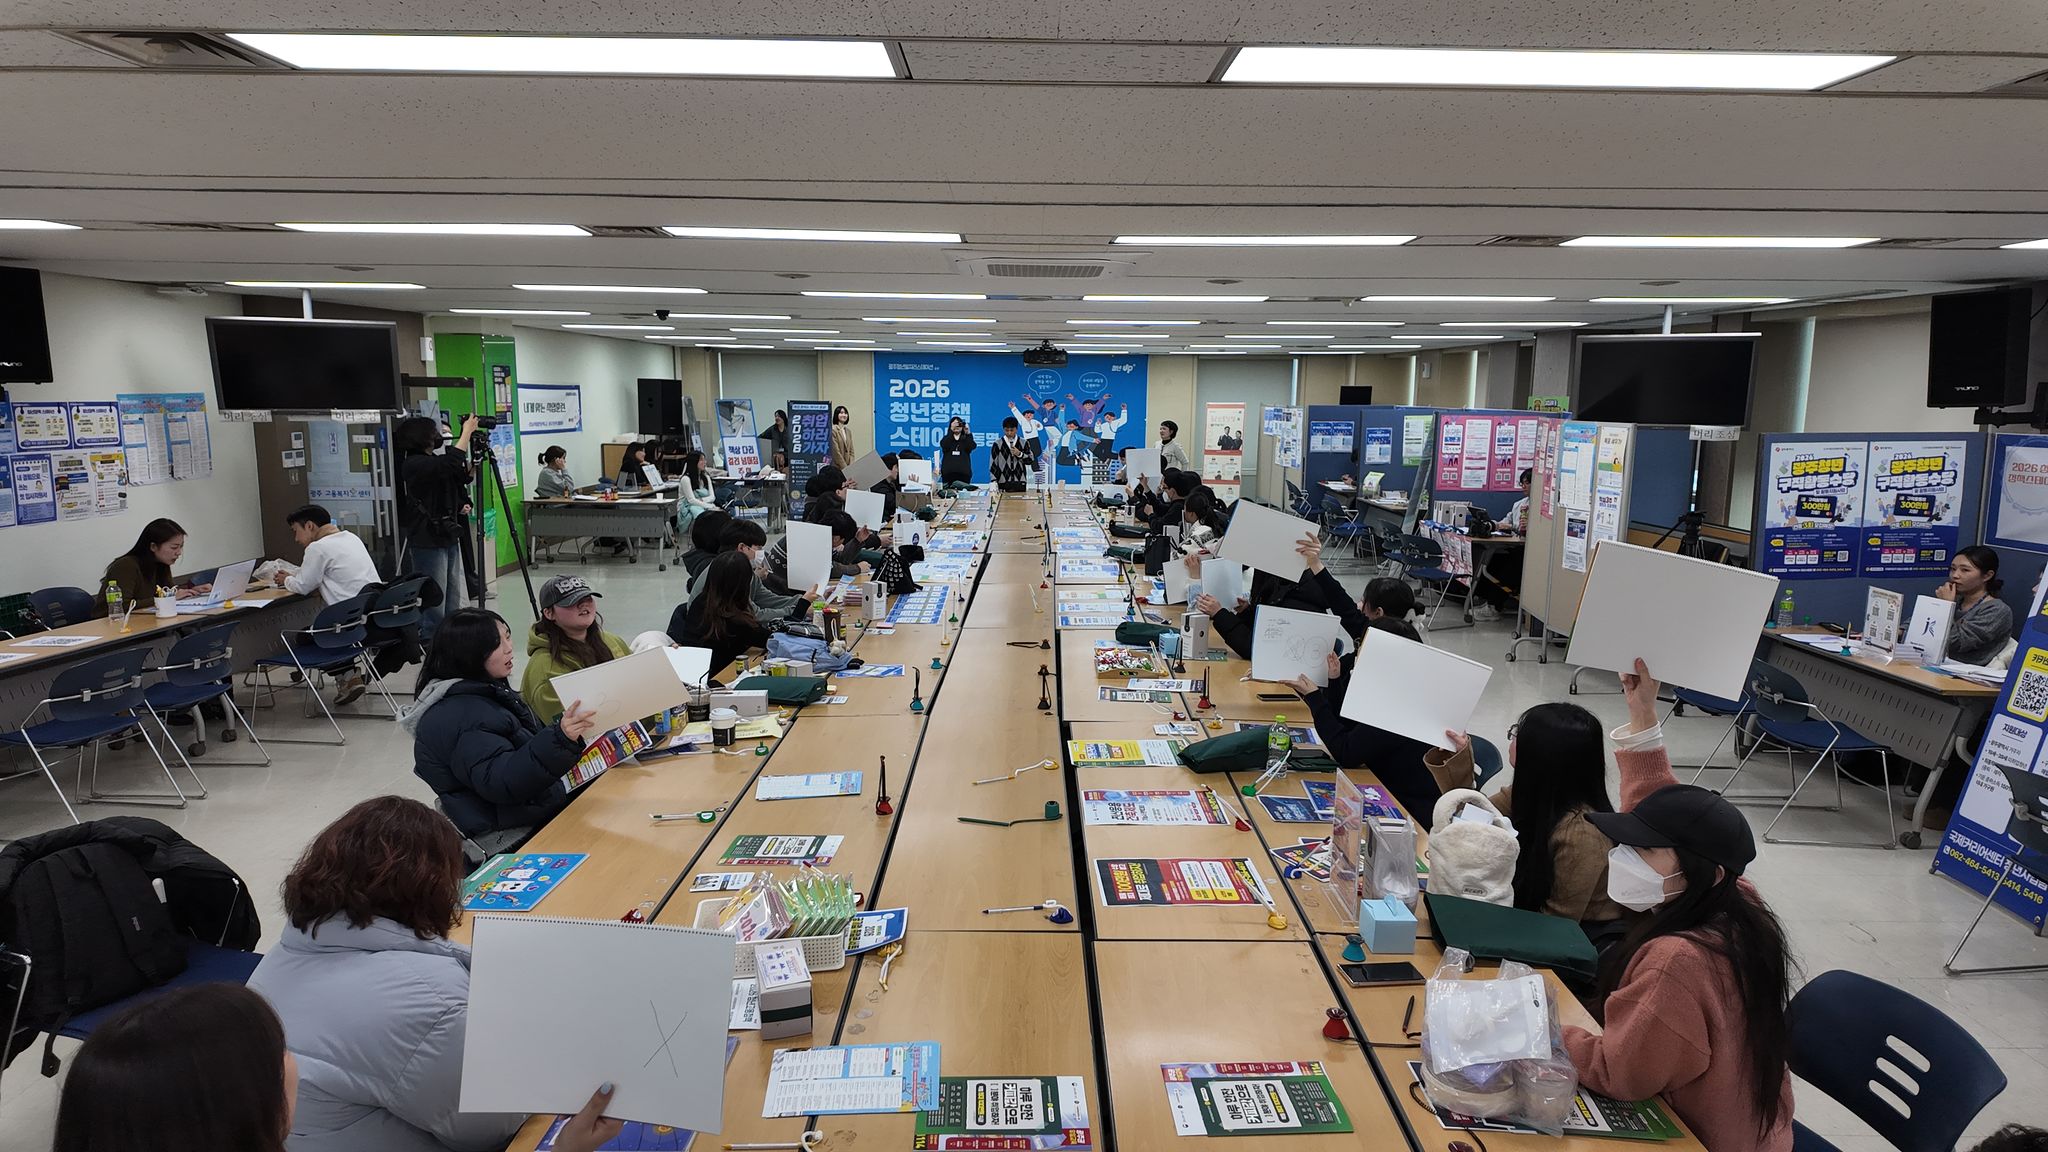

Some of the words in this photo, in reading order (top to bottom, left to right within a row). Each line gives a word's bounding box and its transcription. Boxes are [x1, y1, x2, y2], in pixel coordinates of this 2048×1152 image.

[889, 379, 951, 398] 2026
[223, 411, 244, 422] 머리
[802, 413, 828, 428] 취업
[890, 402, 971, 424] 청년정책
[802, 428, 828, 441] 하러
[890, 427, 950, 447] 스테이
[1694, 429, 1713, 440] 머리
[1716, 429, 1736, 440] 조심
[728, 445, 740, 454] 책상
[742, 445, 754, 454] 다리
[802, 441, 829, 454] 가자
[1792, 459, 1844, 476] 광주청년
[1890, 457, 1944, 474] 광주청년
[2012, 463, 2038, 473] 2026
[1778, 473, 1857, 493] 구직활동수당
[1876, 471, 1955, 491] 구직활동수당
[1801, 502, 1831, 511] 300만원
[1900, 501, 1929, 510] 300만원
[2002, 723, 2028, 739] 지원대상
[1948, 829, 2005, 868] 국제커리어센터
[1135, 884, 1152, 901] 제대로
[2022, 887, 2044, 905] 5416
[1020, 1087, 1033, 1102] 하루
[1220, 1088, 1238, 1104] 한잔
[1002, 1083, 1018, 1125] 커피값으로
[1020, 1103, 1034, 1120] 한잔
[1226, 1104, 1244, 1120] 하루
[1235, 1084, 1263, 1124] 커피값으로
